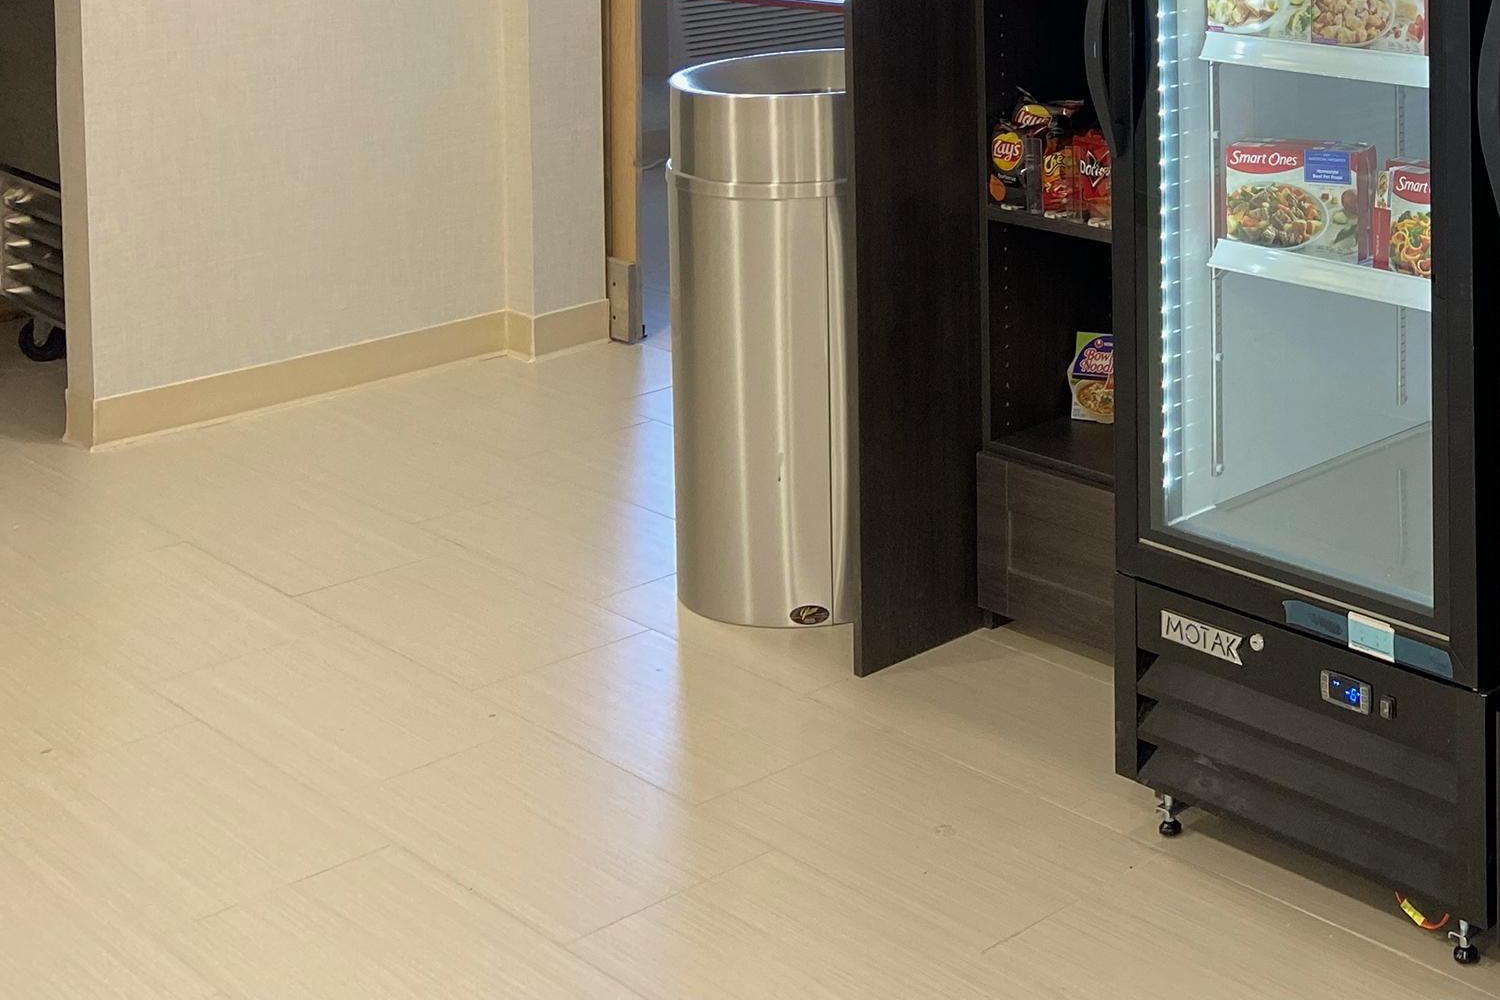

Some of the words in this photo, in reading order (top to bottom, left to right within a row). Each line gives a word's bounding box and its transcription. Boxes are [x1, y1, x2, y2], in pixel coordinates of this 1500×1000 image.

[993, 140, 1021, 161] Lay's
[1230, 150, 1266, 165] Smart
[1268, 152, 1298, 167] Ones
[1396, 176, 1429, 194] Smart
[1084, 348, 1113, 361] Bow
[1080, 358, 1113, 373] Nood
[1166, 616, 1236, 660] MOTAK
